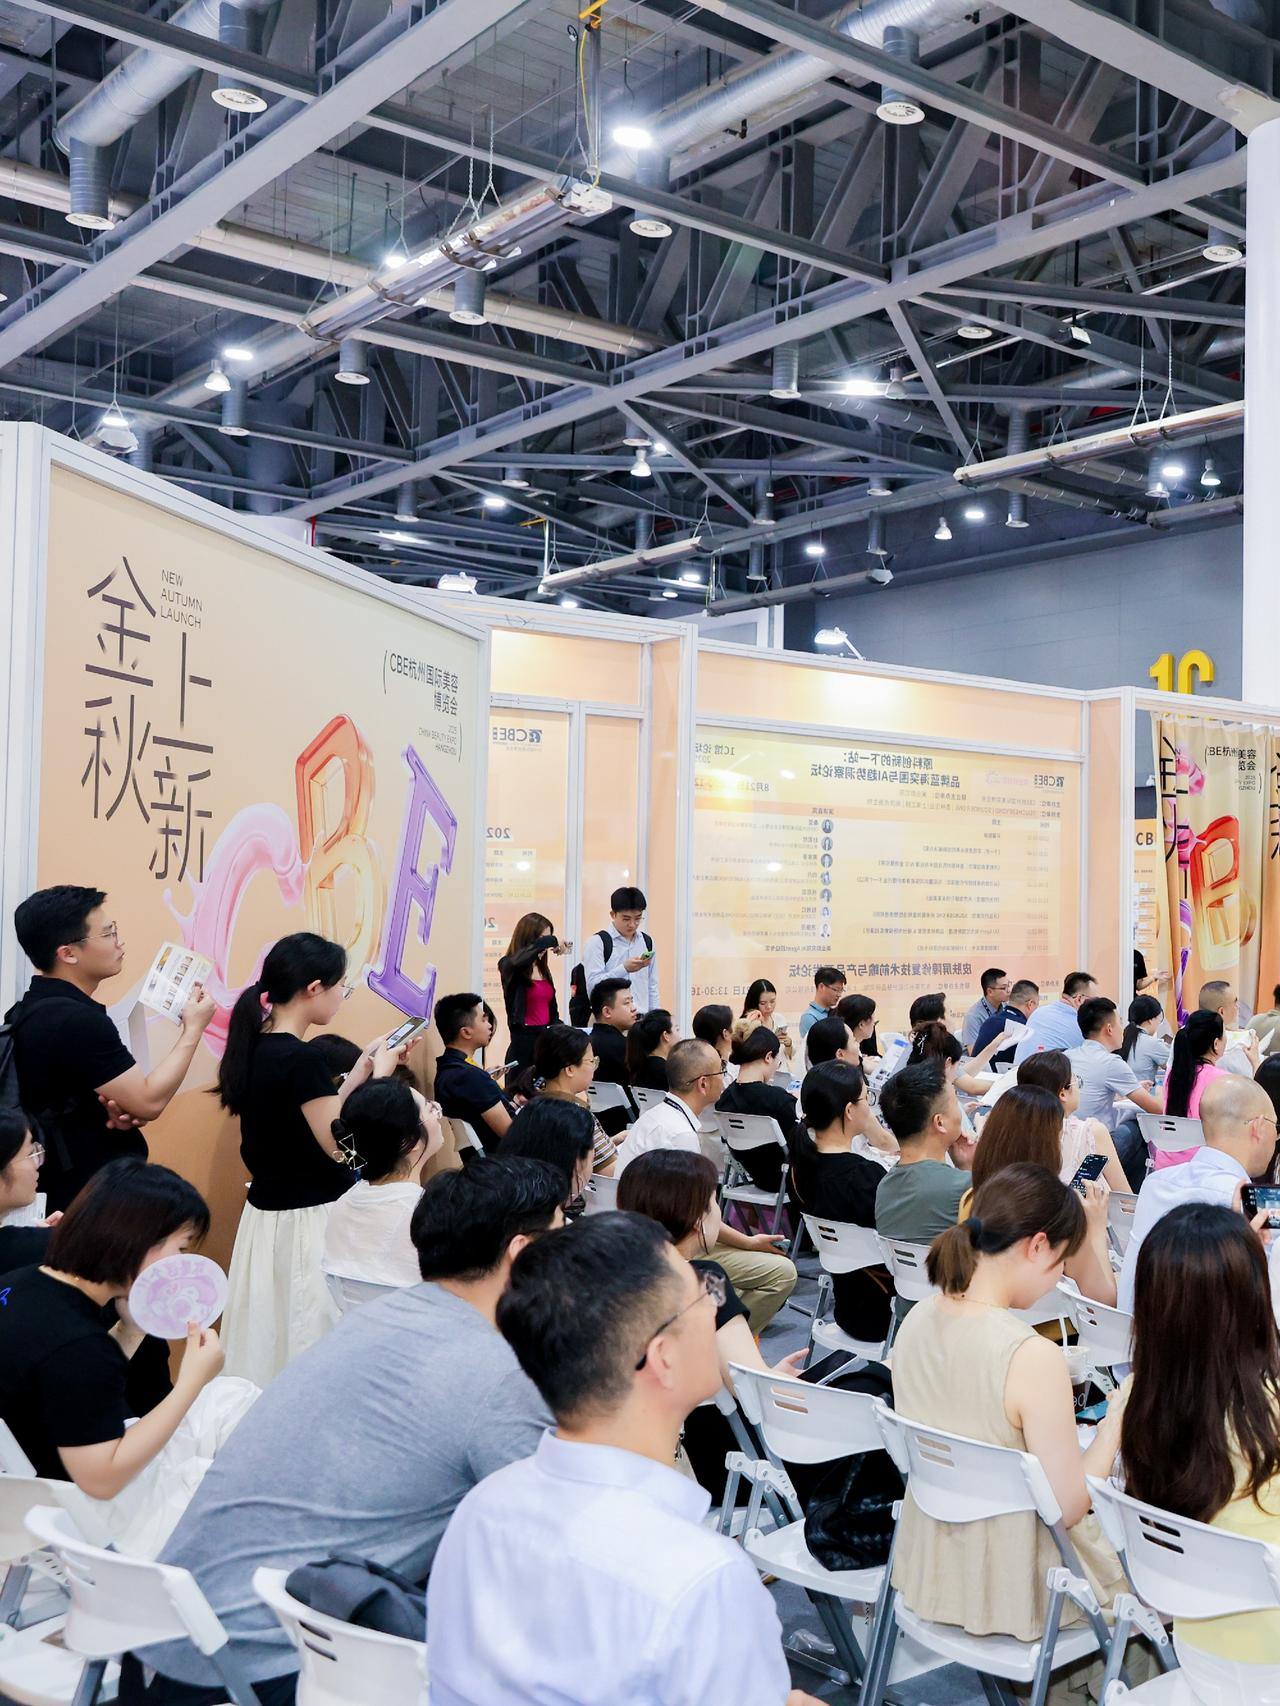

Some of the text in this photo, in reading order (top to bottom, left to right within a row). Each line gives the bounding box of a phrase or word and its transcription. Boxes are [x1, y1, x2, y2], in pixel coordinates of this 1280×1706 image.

[161, 569, 184, 587] NEW
[161, 588, 203, 611] AUTUMN
[161, 605, 201, 629] LAUNCH
